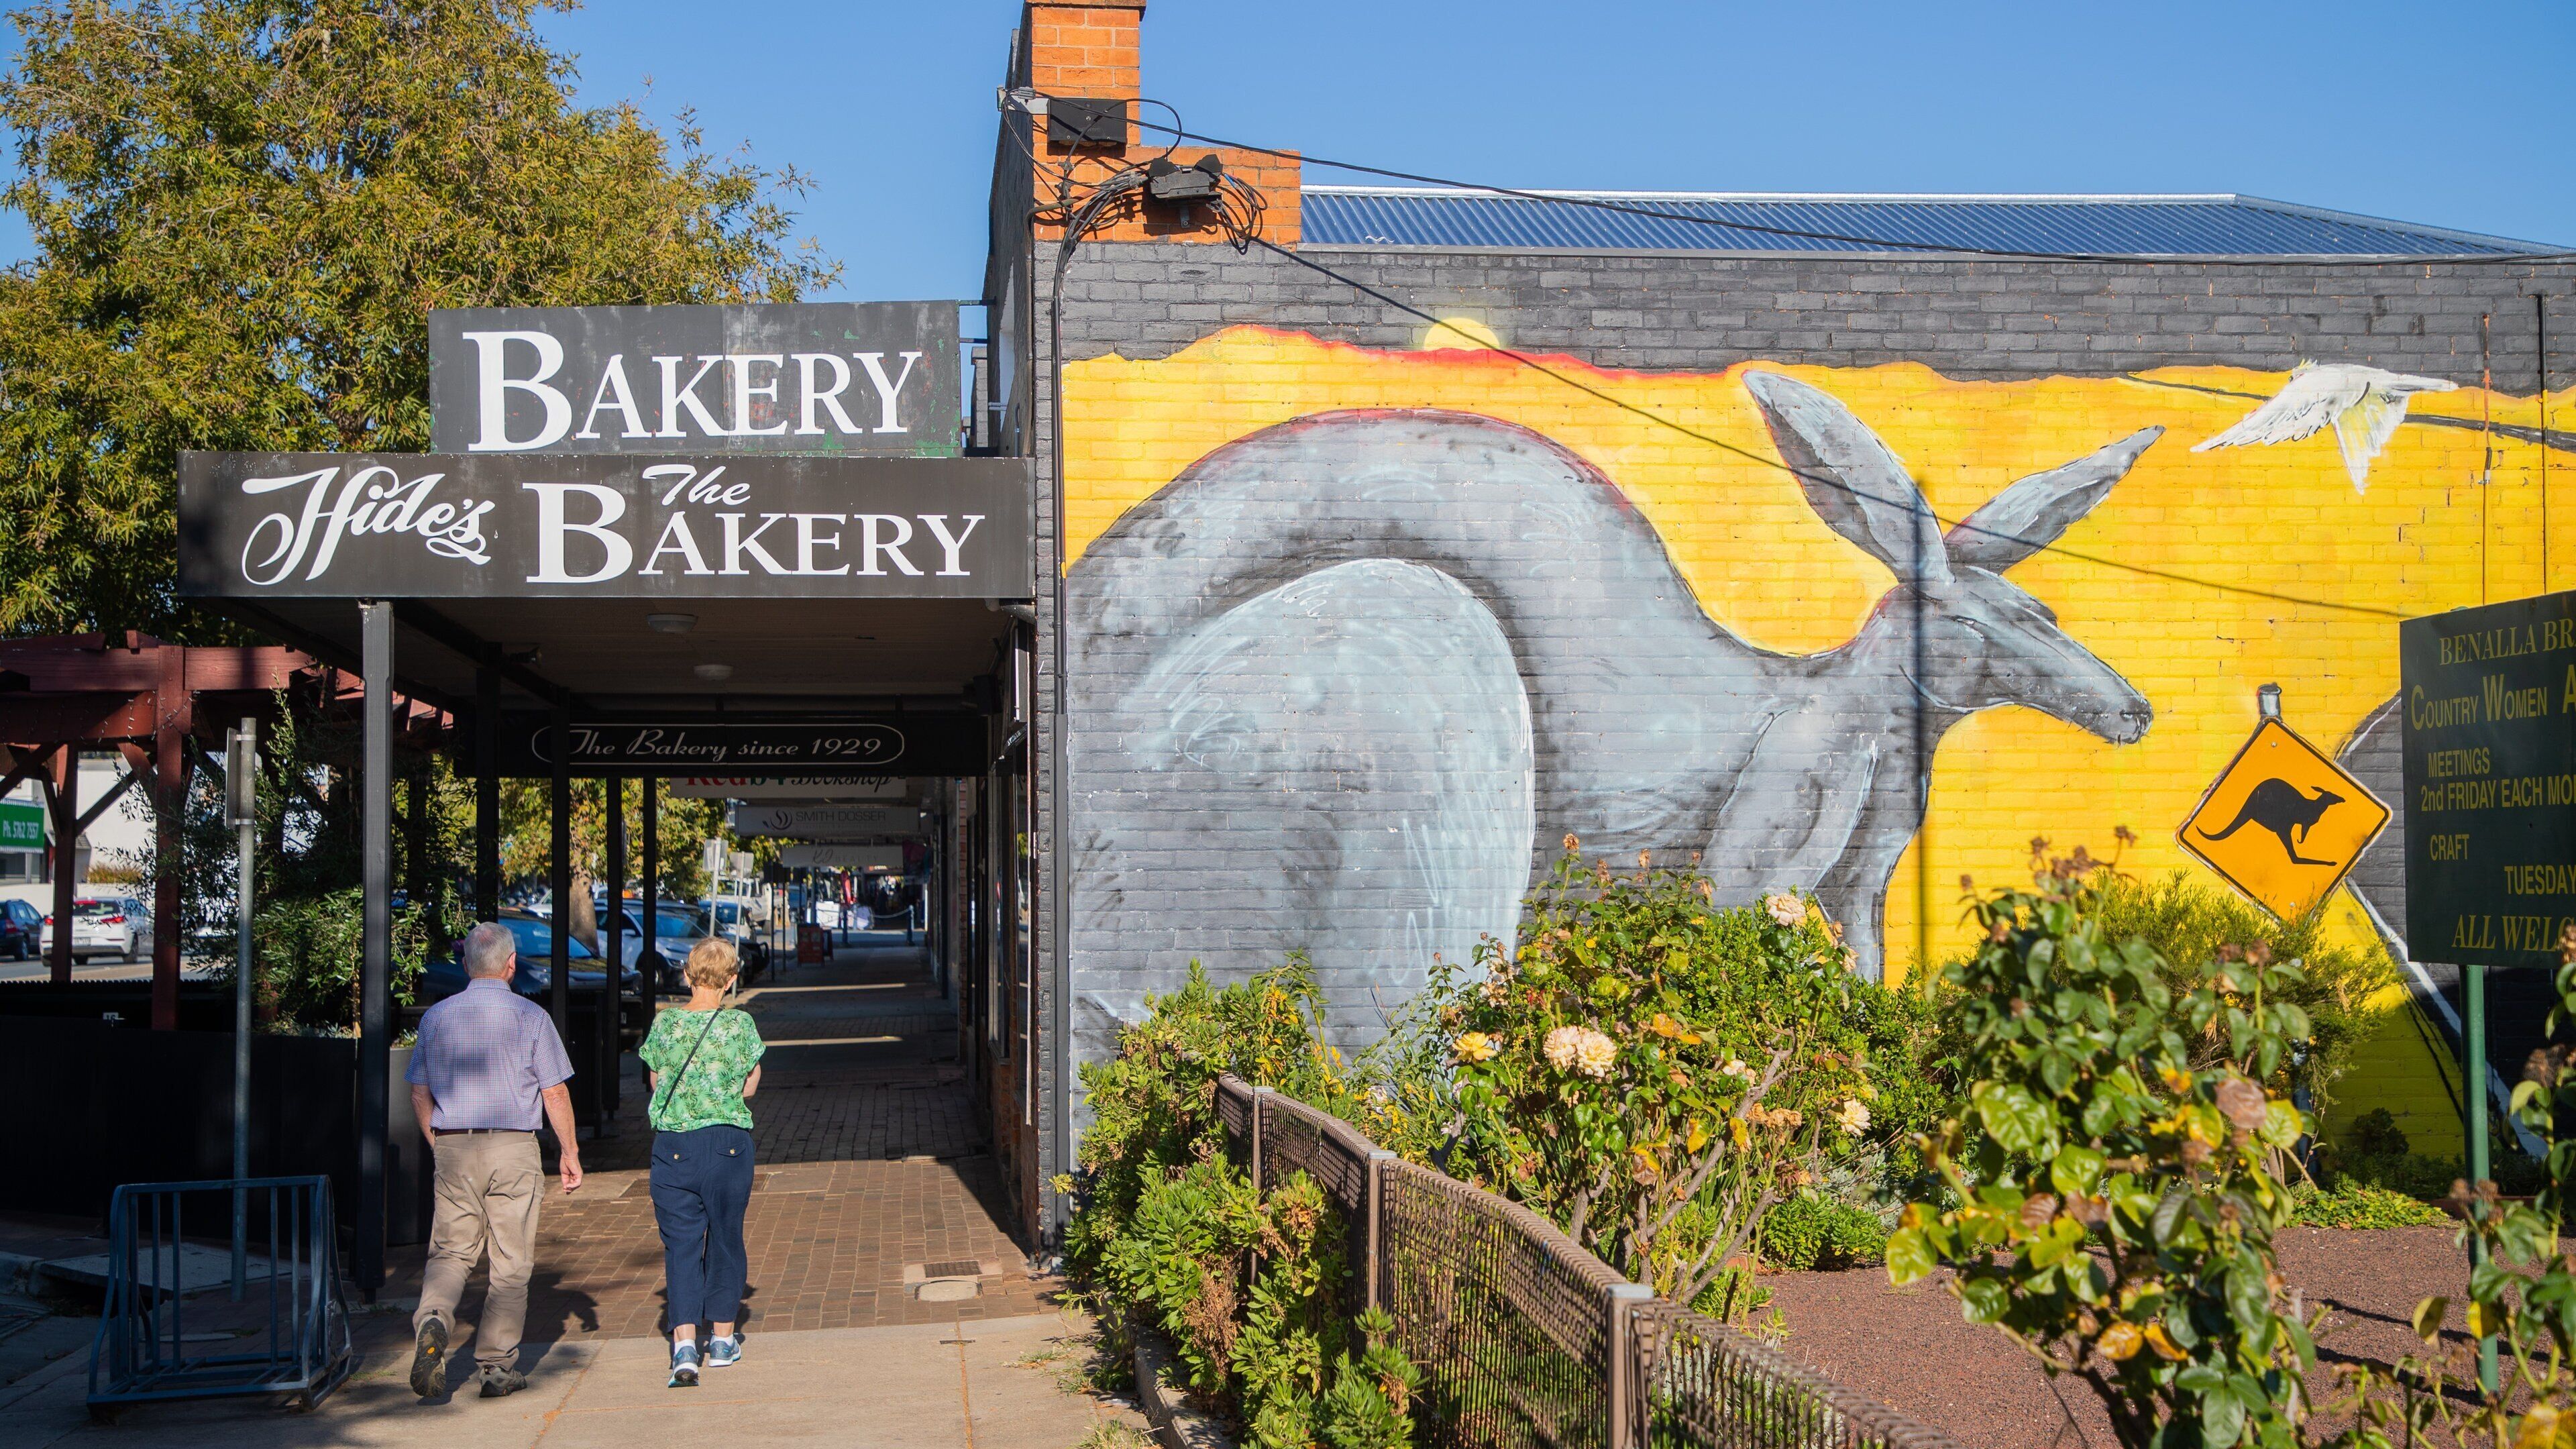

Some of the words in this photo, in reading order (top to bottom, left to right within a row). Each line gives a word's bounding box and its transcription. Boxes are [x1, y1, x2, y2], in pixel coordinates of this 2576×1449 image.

[463, 331, 922, 451] BAKERY
[642, 464, 751, 506] The
[241, 466, 496, 585] Hide's
[523, 482, 985, 583] BAKERY
[2439, 624, 2538, 665] BENALLA
[2542, 618, 2576, 651] BR
[2411, 685, 2479, 730] COUNTRY
[2483, 674, 2547, 722] WOMEN
[569, 729, 616, 755] The
[627, 729, 728, 762] Bakery
[737, 741, 799, 755] since
[811, 738, 881, 755] 1929
[2428, 747, 2490, 778] MEETINGS
[2421, 785, 2444, 812] 2nd
[2448, 780, 2497, 810] FRIDAY
[2501, 776, 2542, 808] EACH
[796, 810, 835, 822] SMITH
[839, 810, 886, 822] DOSSER
[2430, 834, 2469, 861] CRAFT
[2504, 864, 2576, 895] TUESDAY
[2451, 914, 2497, 949] ALL
